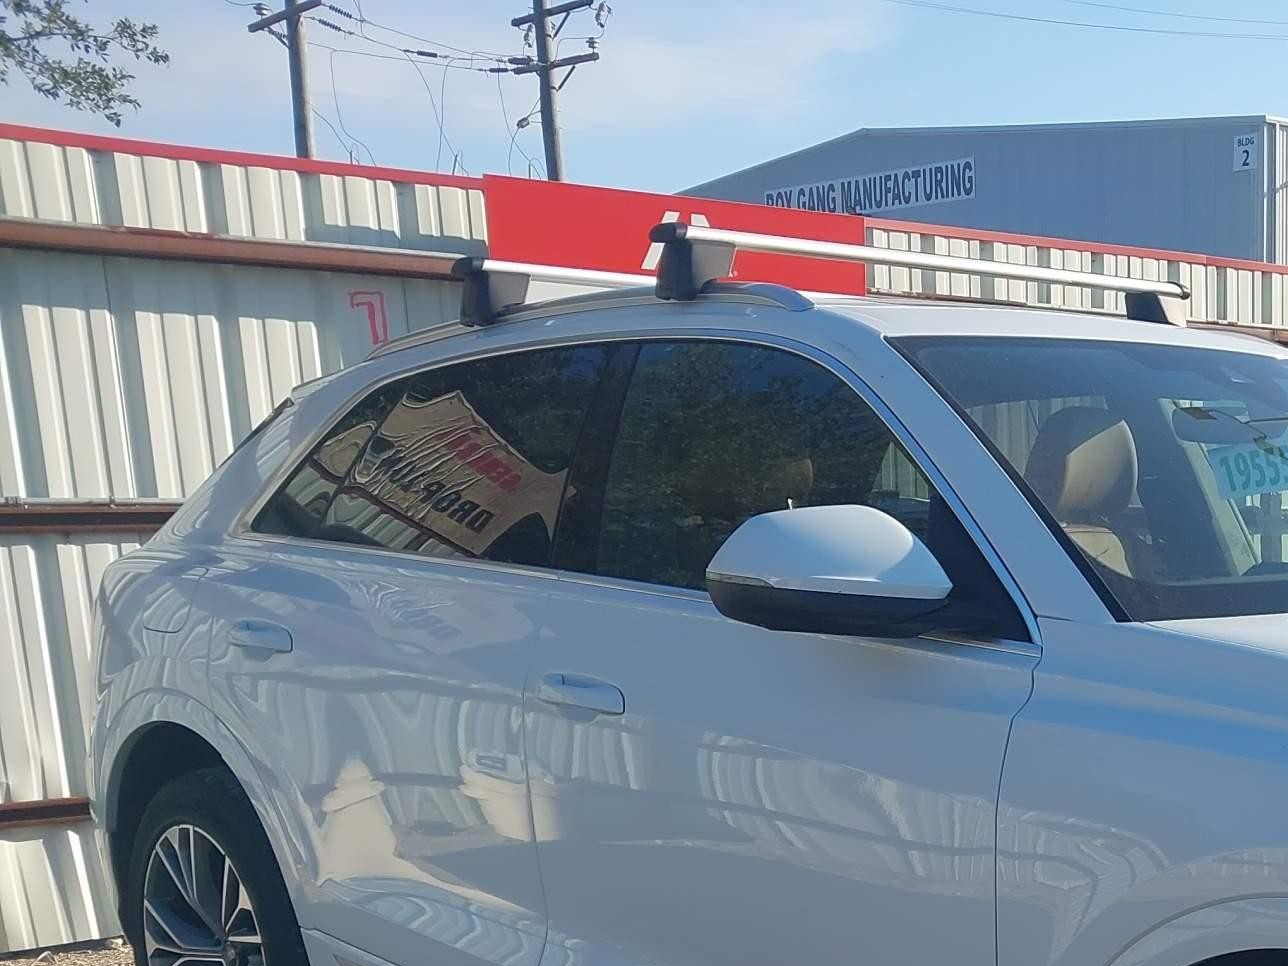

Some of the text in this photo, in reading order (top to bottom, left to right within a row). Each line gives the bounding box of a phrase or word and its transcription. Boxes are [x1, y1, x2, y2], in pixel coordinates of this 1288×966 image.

[1237, 136, 1255, 147] BLDG
[1242, 149, 1250, 167] 2
[797, 183, 837, 212] GANG
[840, 161, 974, 213] MANUFACTURING
